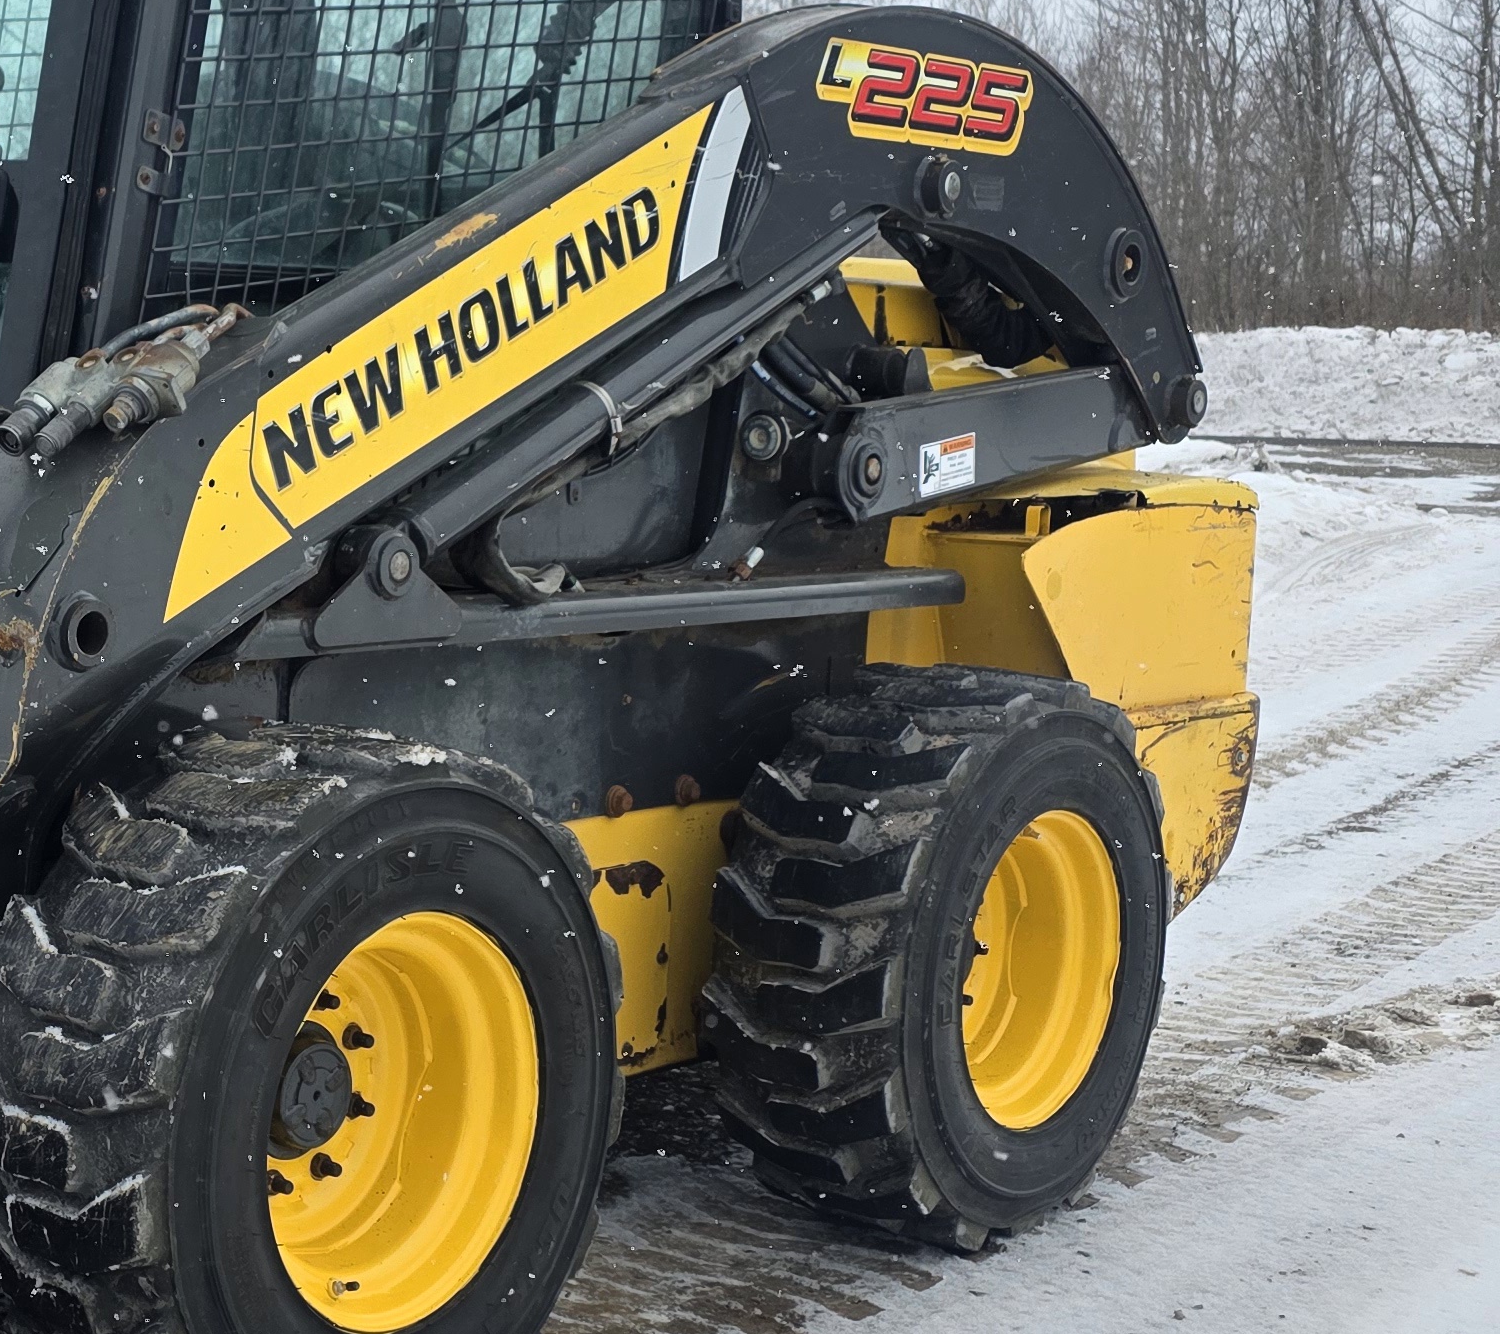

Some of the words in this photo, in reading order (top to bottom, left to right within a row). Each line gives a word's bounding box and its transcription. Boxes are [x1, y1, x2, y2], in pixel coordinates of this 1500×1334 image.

[818, 41, 1030, 144] L225
[263, 344, 404, 492] NEW
[414, 187, 660, 395] HOLLAND
[253, 841, 477, 1039] CARLISLE
